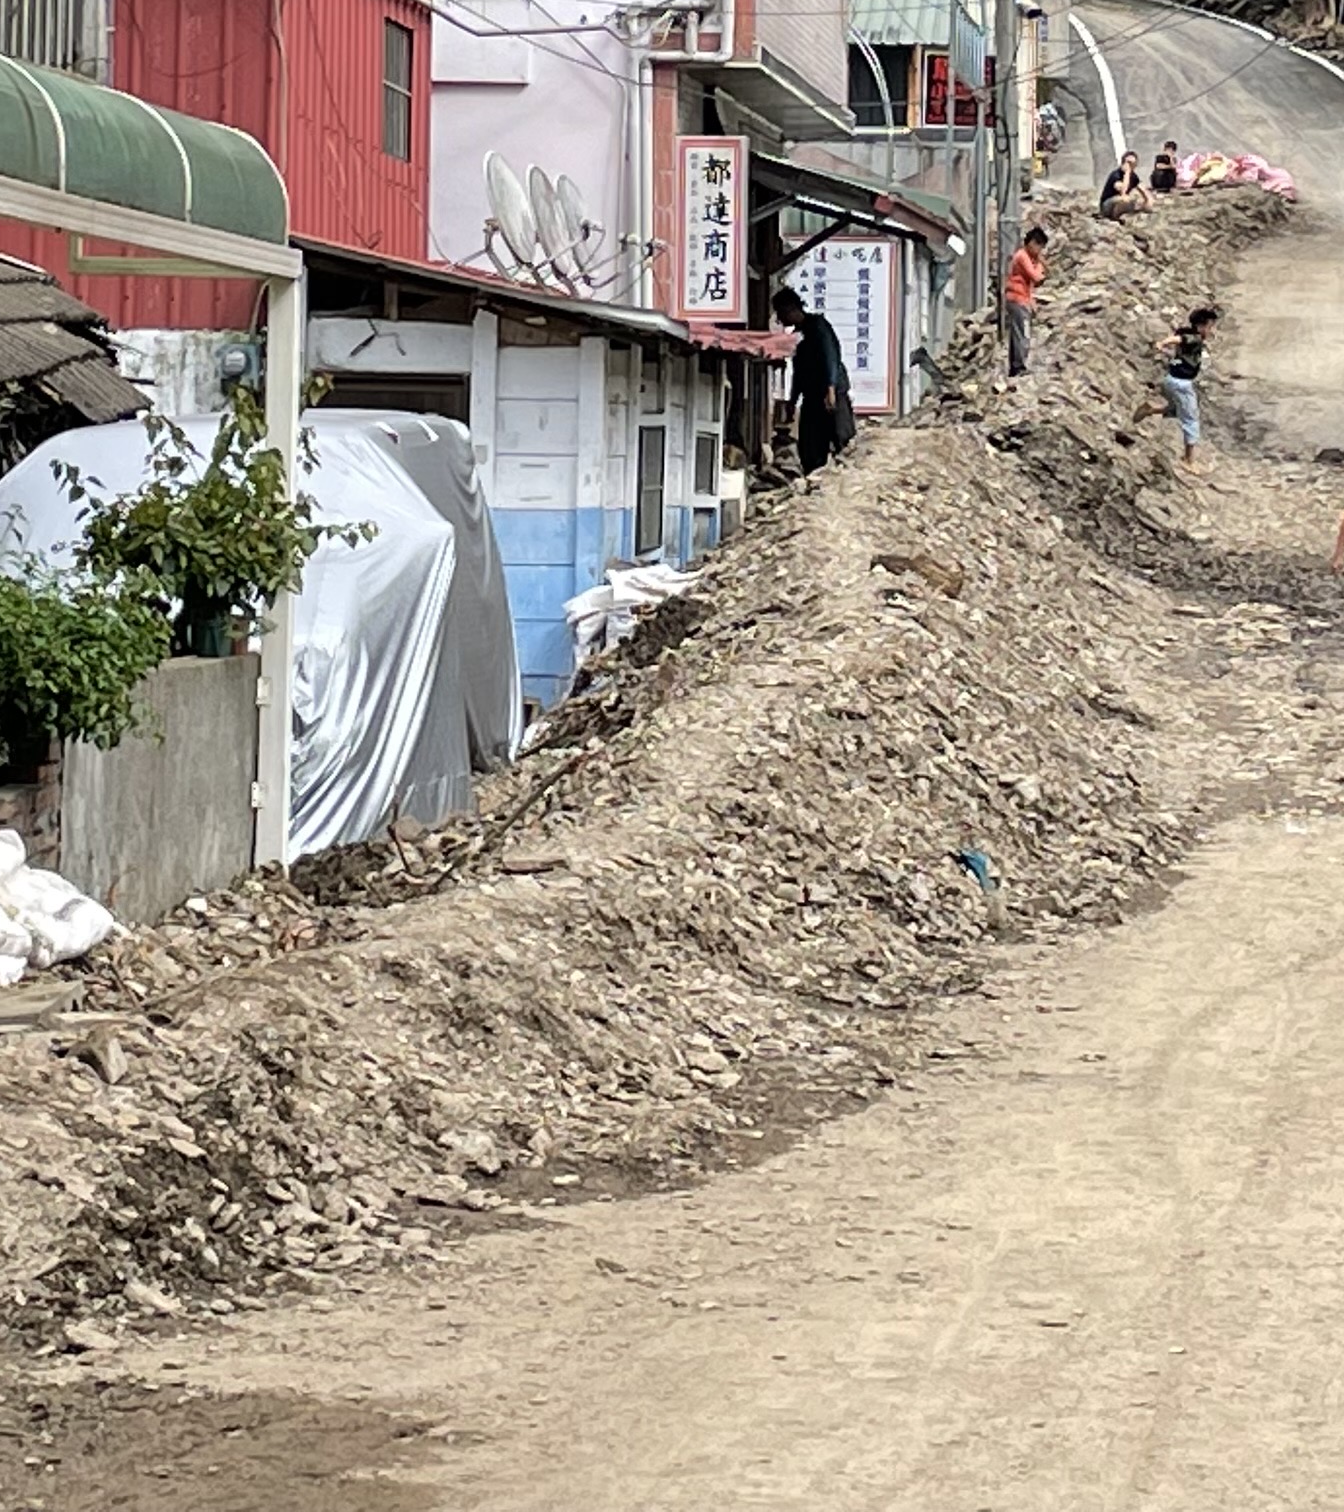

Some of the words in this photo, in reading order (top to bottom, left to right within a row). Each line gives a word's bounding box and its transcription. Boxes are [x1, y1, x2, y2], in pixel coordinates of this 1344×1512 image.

[699, 152, 733, 302] 都達商店
[804, 245, 884, 264] 達小吃店
